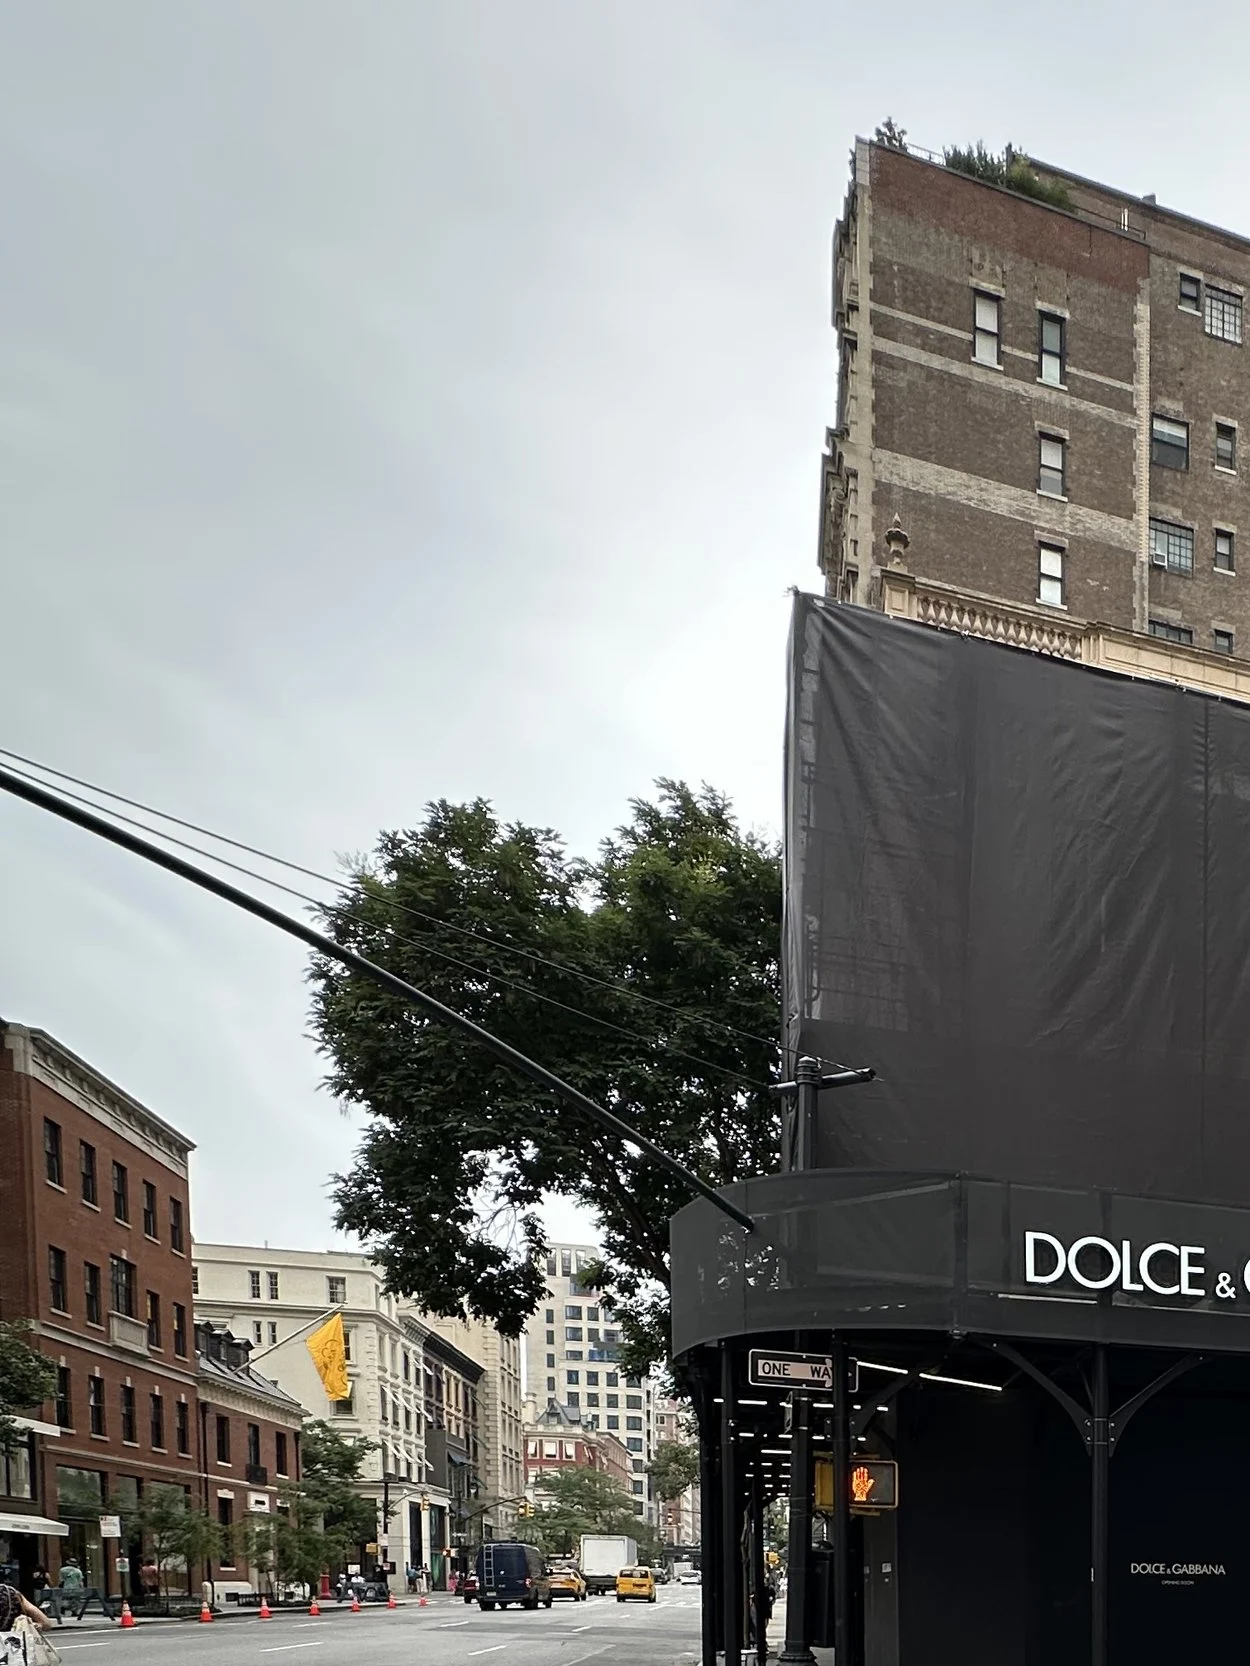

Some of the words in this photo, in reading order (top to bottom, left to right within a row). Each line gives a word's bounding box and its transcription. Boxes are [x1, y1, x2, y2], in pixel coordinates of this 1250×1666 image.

[1024, 1230, 1206, 1297] DOLCE
[1215, 1272, 1236, 1299] &
[762, 1361, 791, 1376] ONE
[1130, 1563, 1166, 1575] DOLCE
[1172, 1563, 1226, 1575] GABBANA
